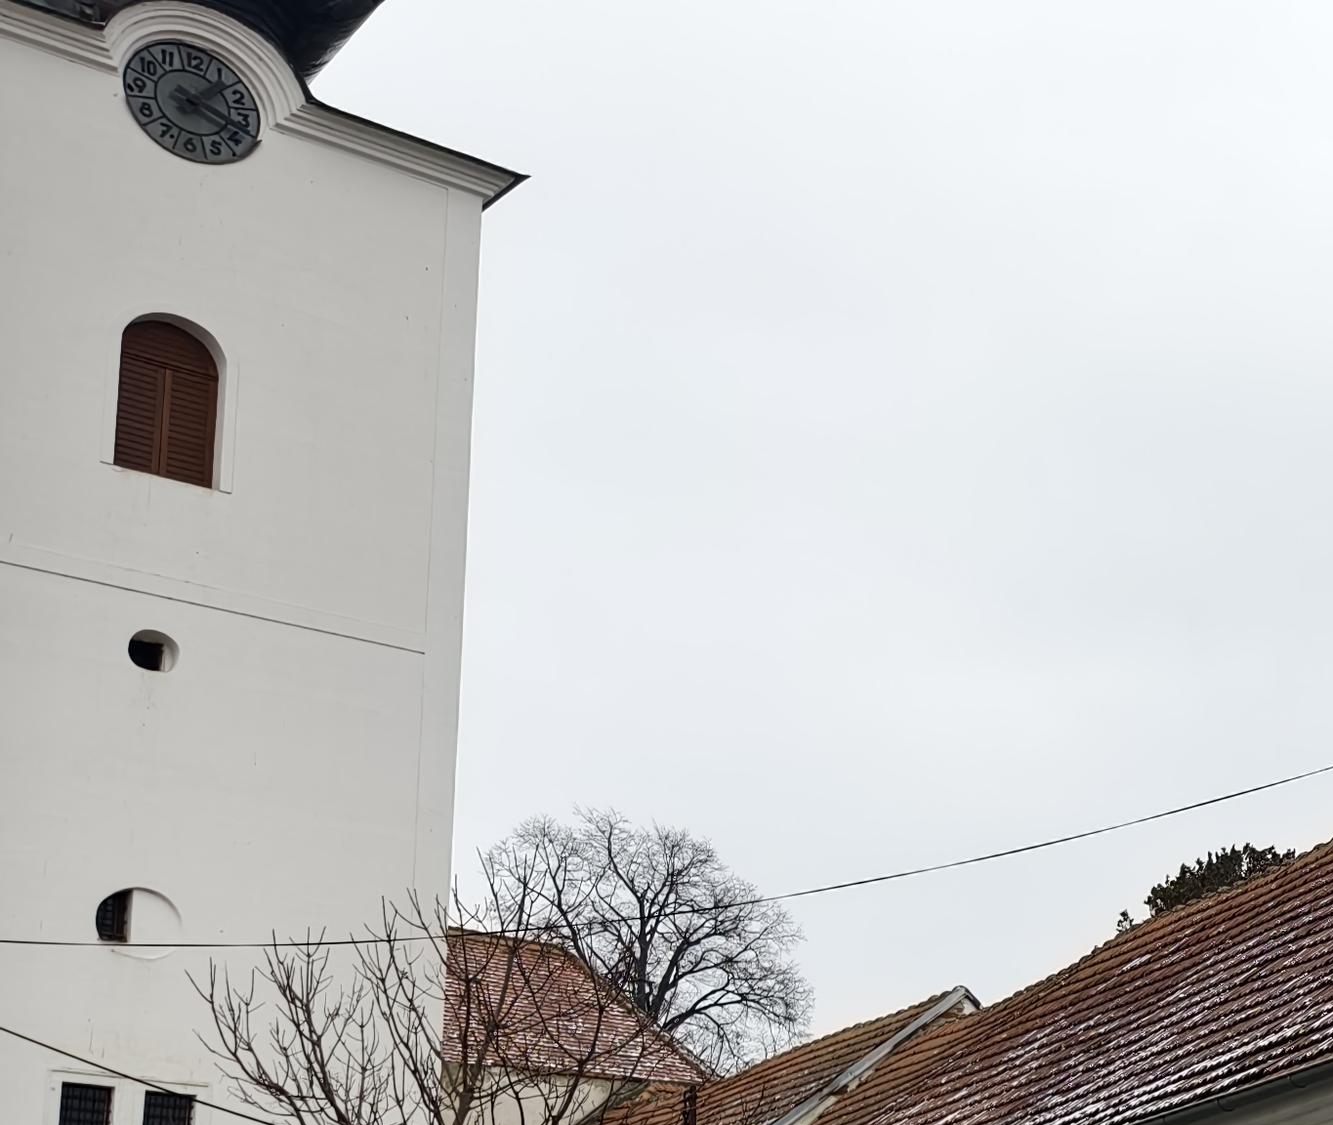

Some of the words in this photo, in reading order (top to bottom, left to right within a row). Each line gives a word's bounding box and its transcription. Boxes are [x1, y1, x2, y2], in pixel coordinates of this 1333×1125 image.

[161, 49, 174, 67] 11
[186, 52, 203, 72] 12
[140, 57, 157, 76] 10
[132, 77, 146, 93] 9
[232, 89, 245, 106] 2
[139, 102, 153, 118] 8
[237, 112, 250, 128] 3
[160, 122, 174, 138] 7
[183, 138, 196, 153] 6
[209, 140, 222, 156] 5
